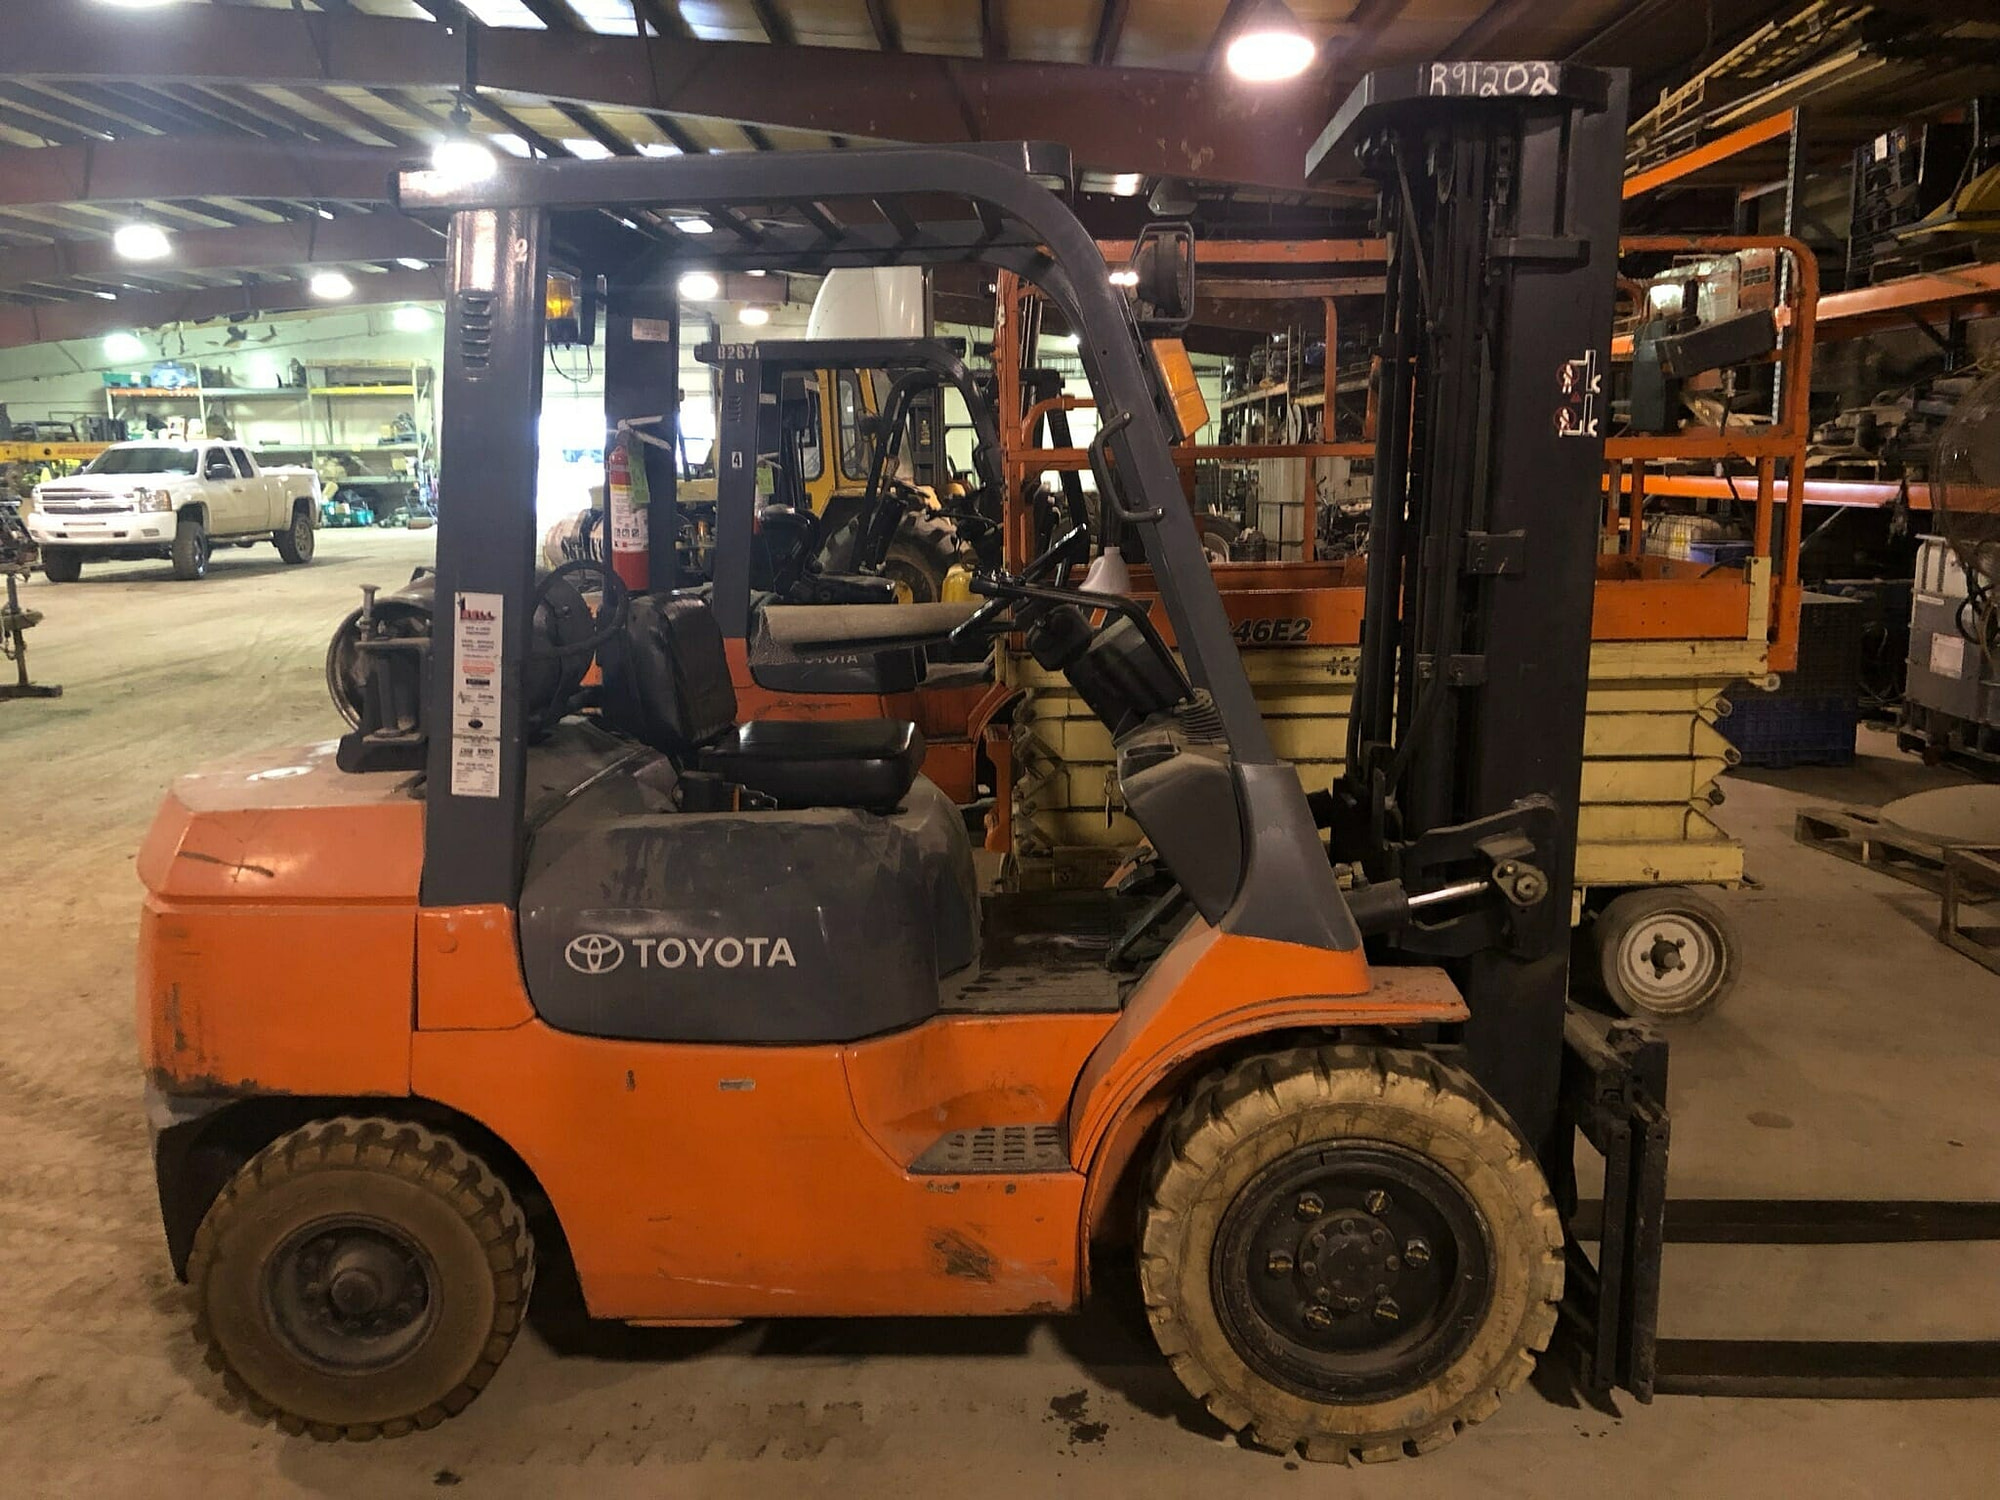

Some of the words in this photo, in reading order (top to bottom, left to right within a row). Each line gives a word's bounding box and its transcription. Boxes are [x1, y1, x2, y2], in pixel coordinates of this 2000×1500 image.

[1429, 62, 1558, 97] R91202
[1230, 617, 1313, 643] 46E2
[632, 937, 797, 968] TOYOTA
